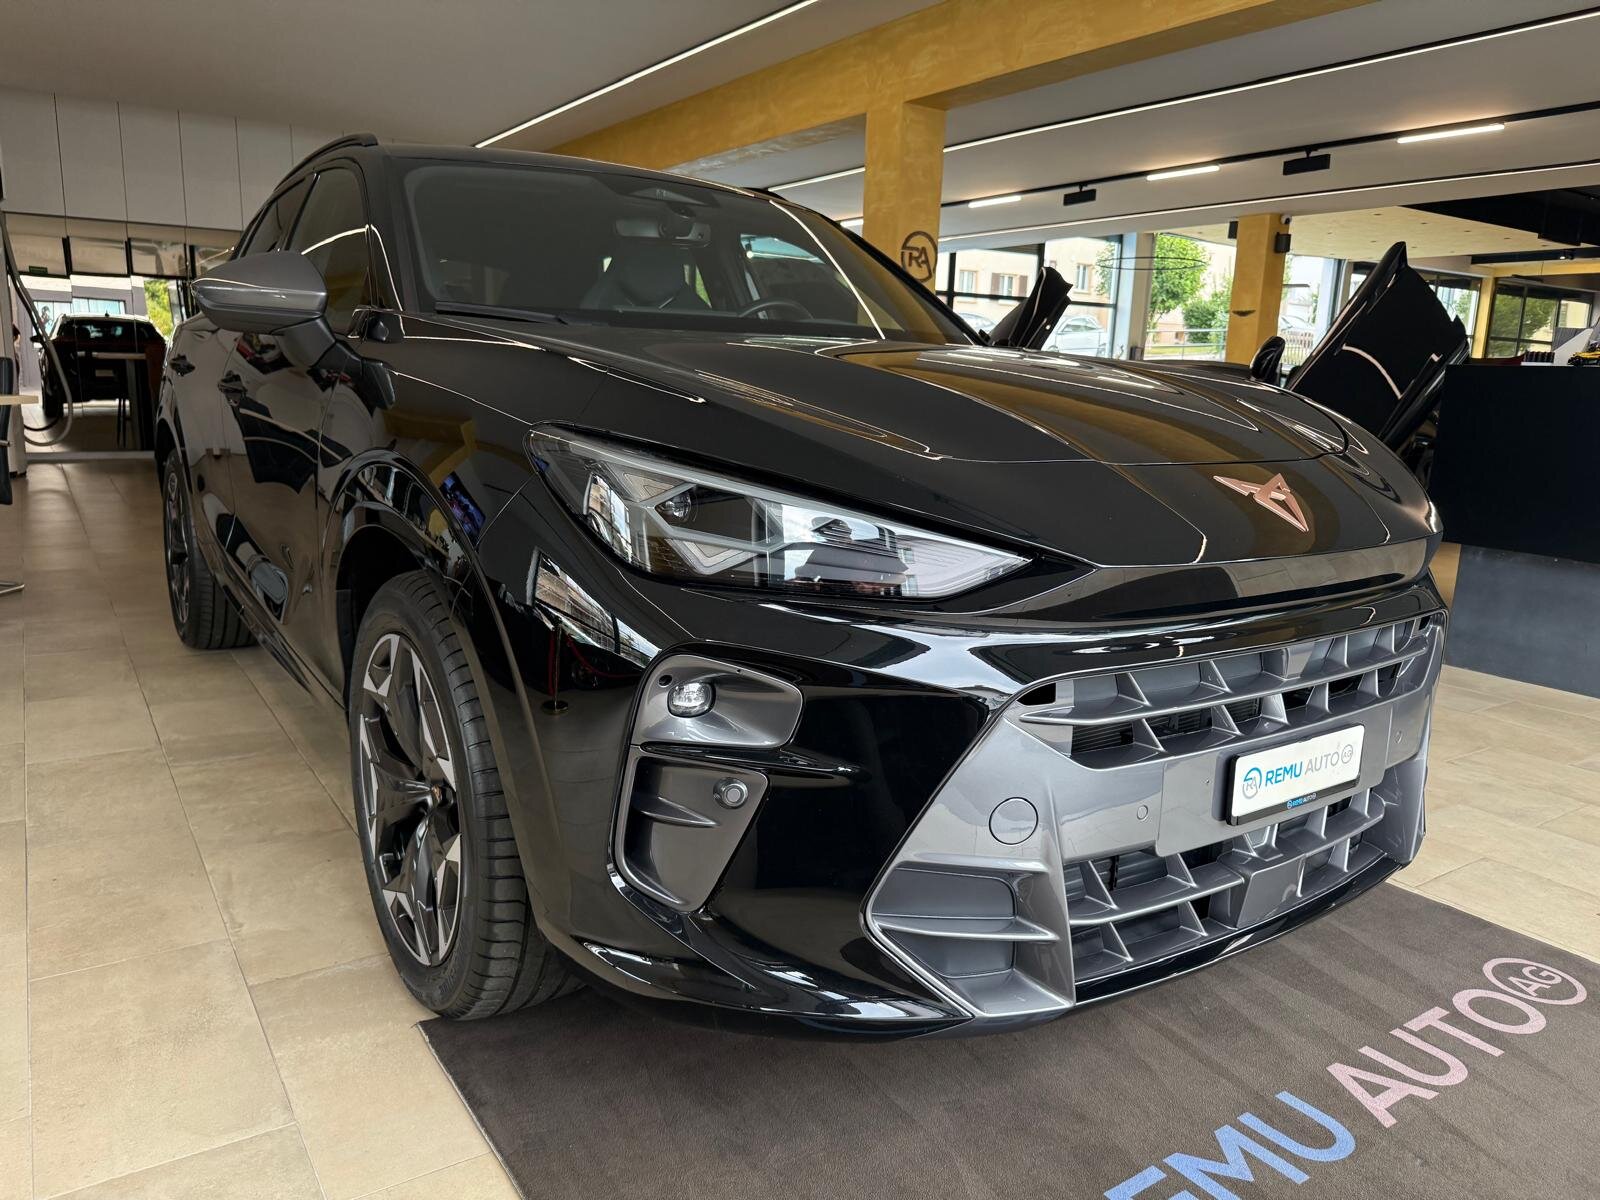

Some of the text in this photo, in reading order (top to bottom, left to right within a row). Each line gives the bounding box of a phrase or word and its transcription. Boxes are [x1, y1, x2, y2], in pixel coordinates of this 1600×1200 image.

[1265, 761, 1303, 787] REMU
[1304, 752, 1340, 775] AUTO
[1326, 988, 1547, 1128] AUTO
[1507, 965, 1562, 997] AG
